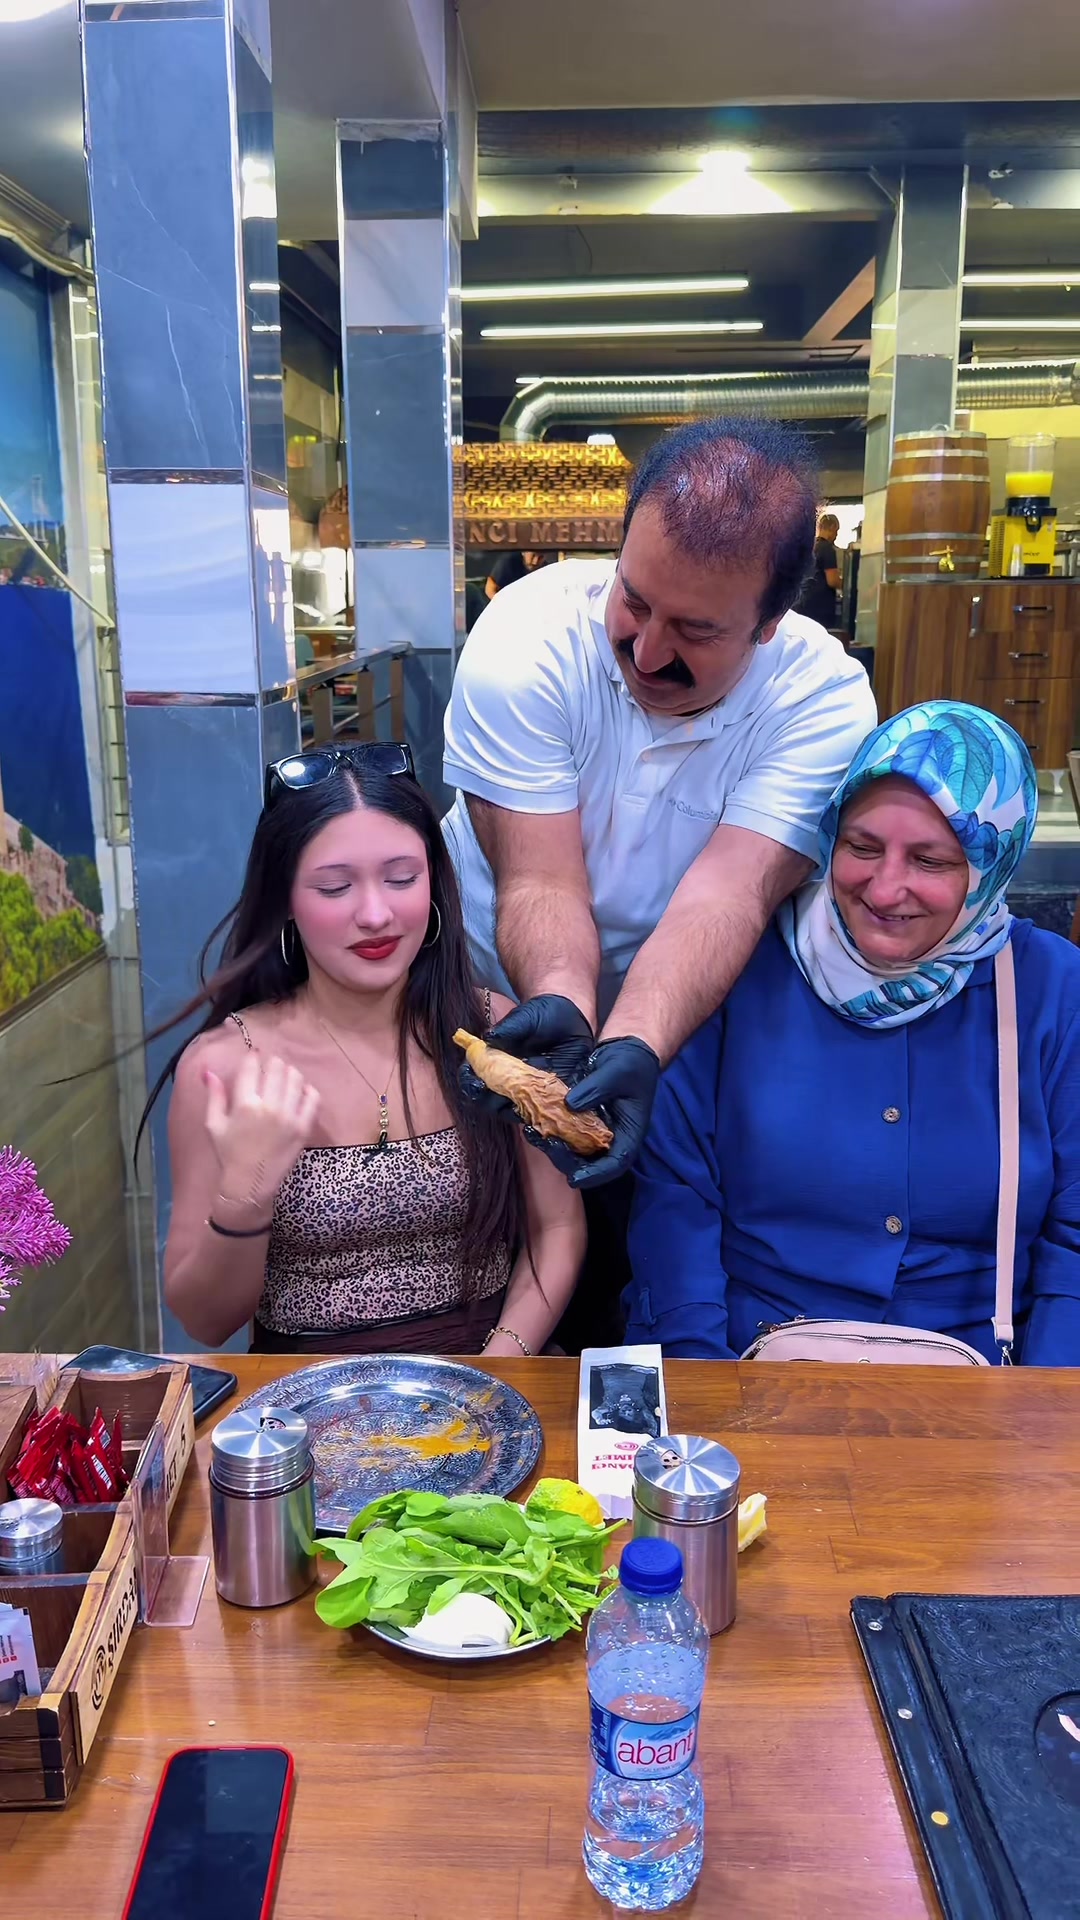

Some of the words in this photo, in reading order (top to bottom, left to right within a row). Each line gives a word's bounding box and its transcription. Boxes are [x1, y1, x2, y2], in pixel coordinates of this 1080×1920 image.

[469, 521, 519, 543] NCI
[530, 521, 619, 543] MEHM
[617, 1729, 693, 1766] abant
